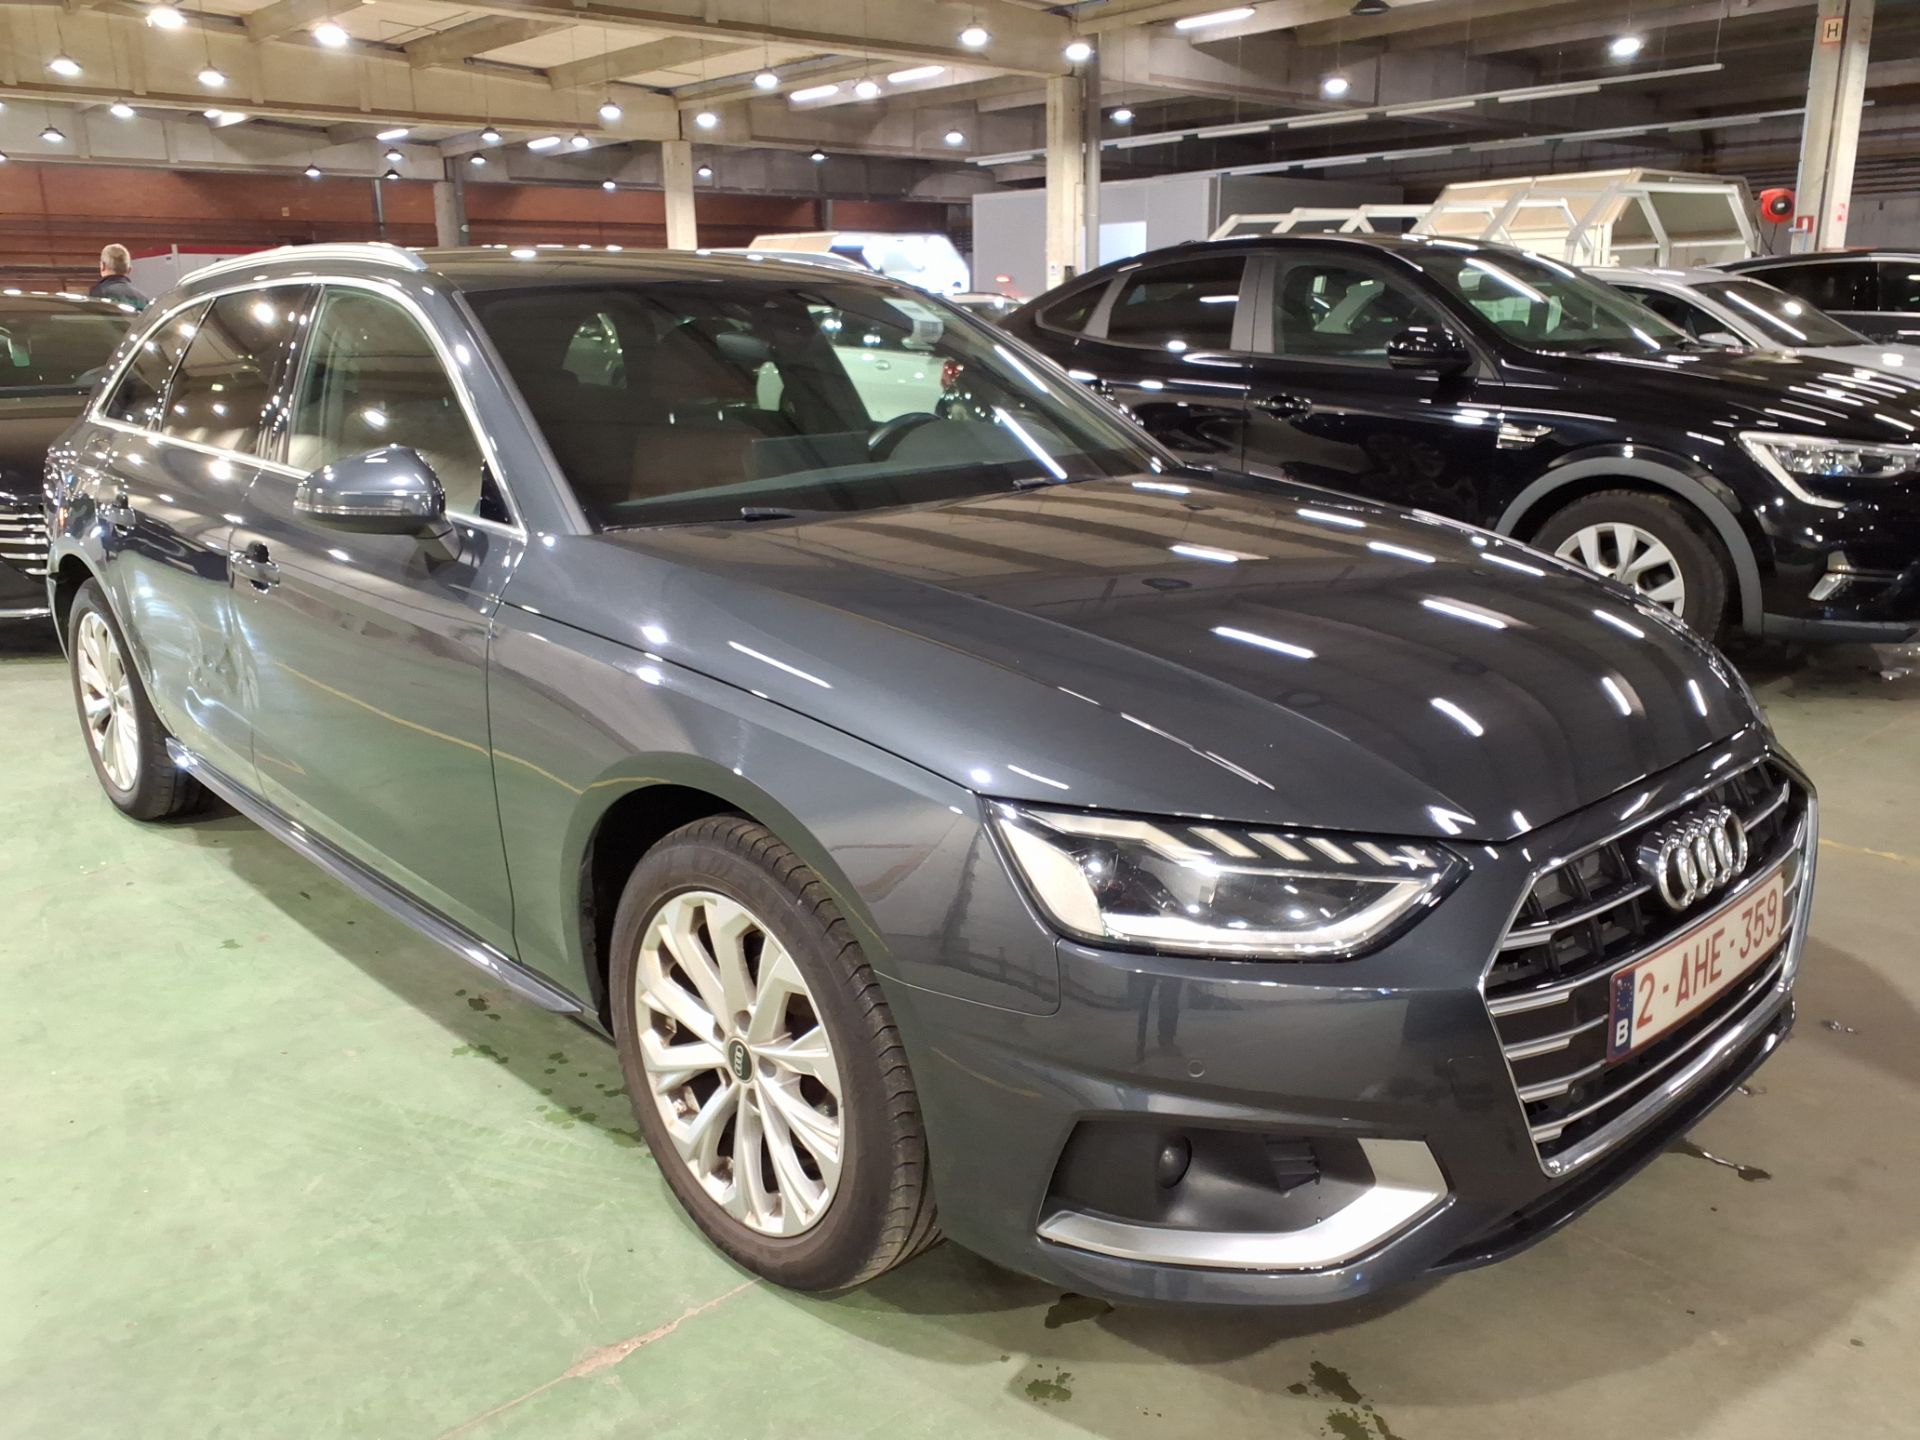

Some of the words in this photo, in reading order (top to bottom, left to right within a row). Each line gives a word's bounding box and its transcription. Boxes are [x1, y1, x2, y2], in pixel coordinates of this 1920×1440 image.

[1826, 23, 1839, 39] H
[1636, 888, 1777, 1030] 2-AHE-359
[1615, 1018, 1629, 1047] B
